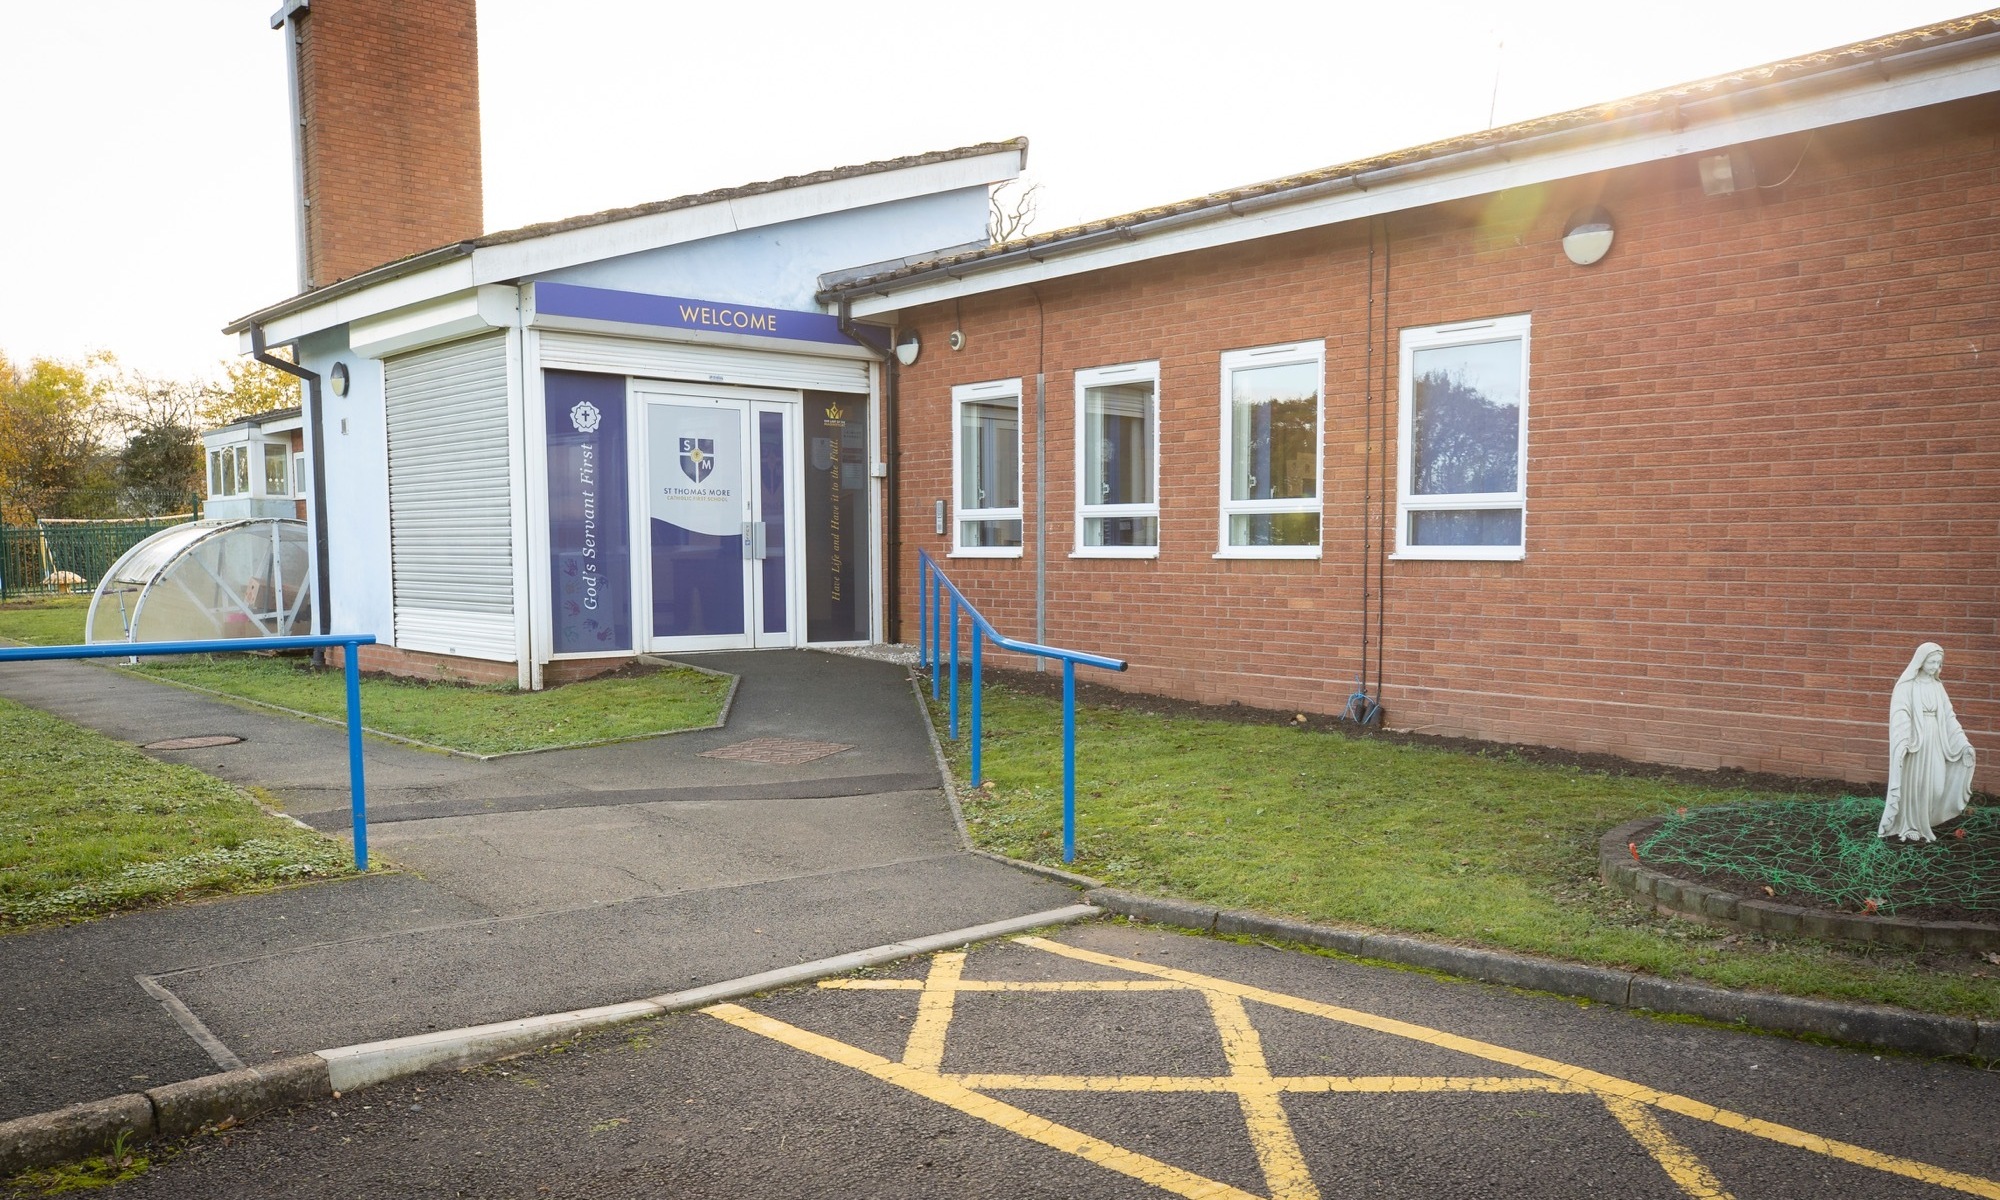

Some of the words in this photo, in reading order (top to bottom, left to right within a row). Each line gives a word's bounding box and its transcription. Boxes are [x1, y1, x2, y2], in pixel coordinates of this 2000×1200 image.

[680, 305, 776, 331] WELCOME
[683, 440, 691, 451] S
[580, 443, 594, 486] First
[701, 460, 712, 470] M
[830, 465, 839, 478] the
[663, 487, 672, 495] ST
[674, 488, 707, 496] THOMAS
[708, 489, 731, 497] MORE
[582, 490, 596, 559] Servant
[831, 506, 840, 530] Have
[831, 533, 840, 551] and
[831, 554, 842, 573] Life
[831, 576, 840, 601] Have
